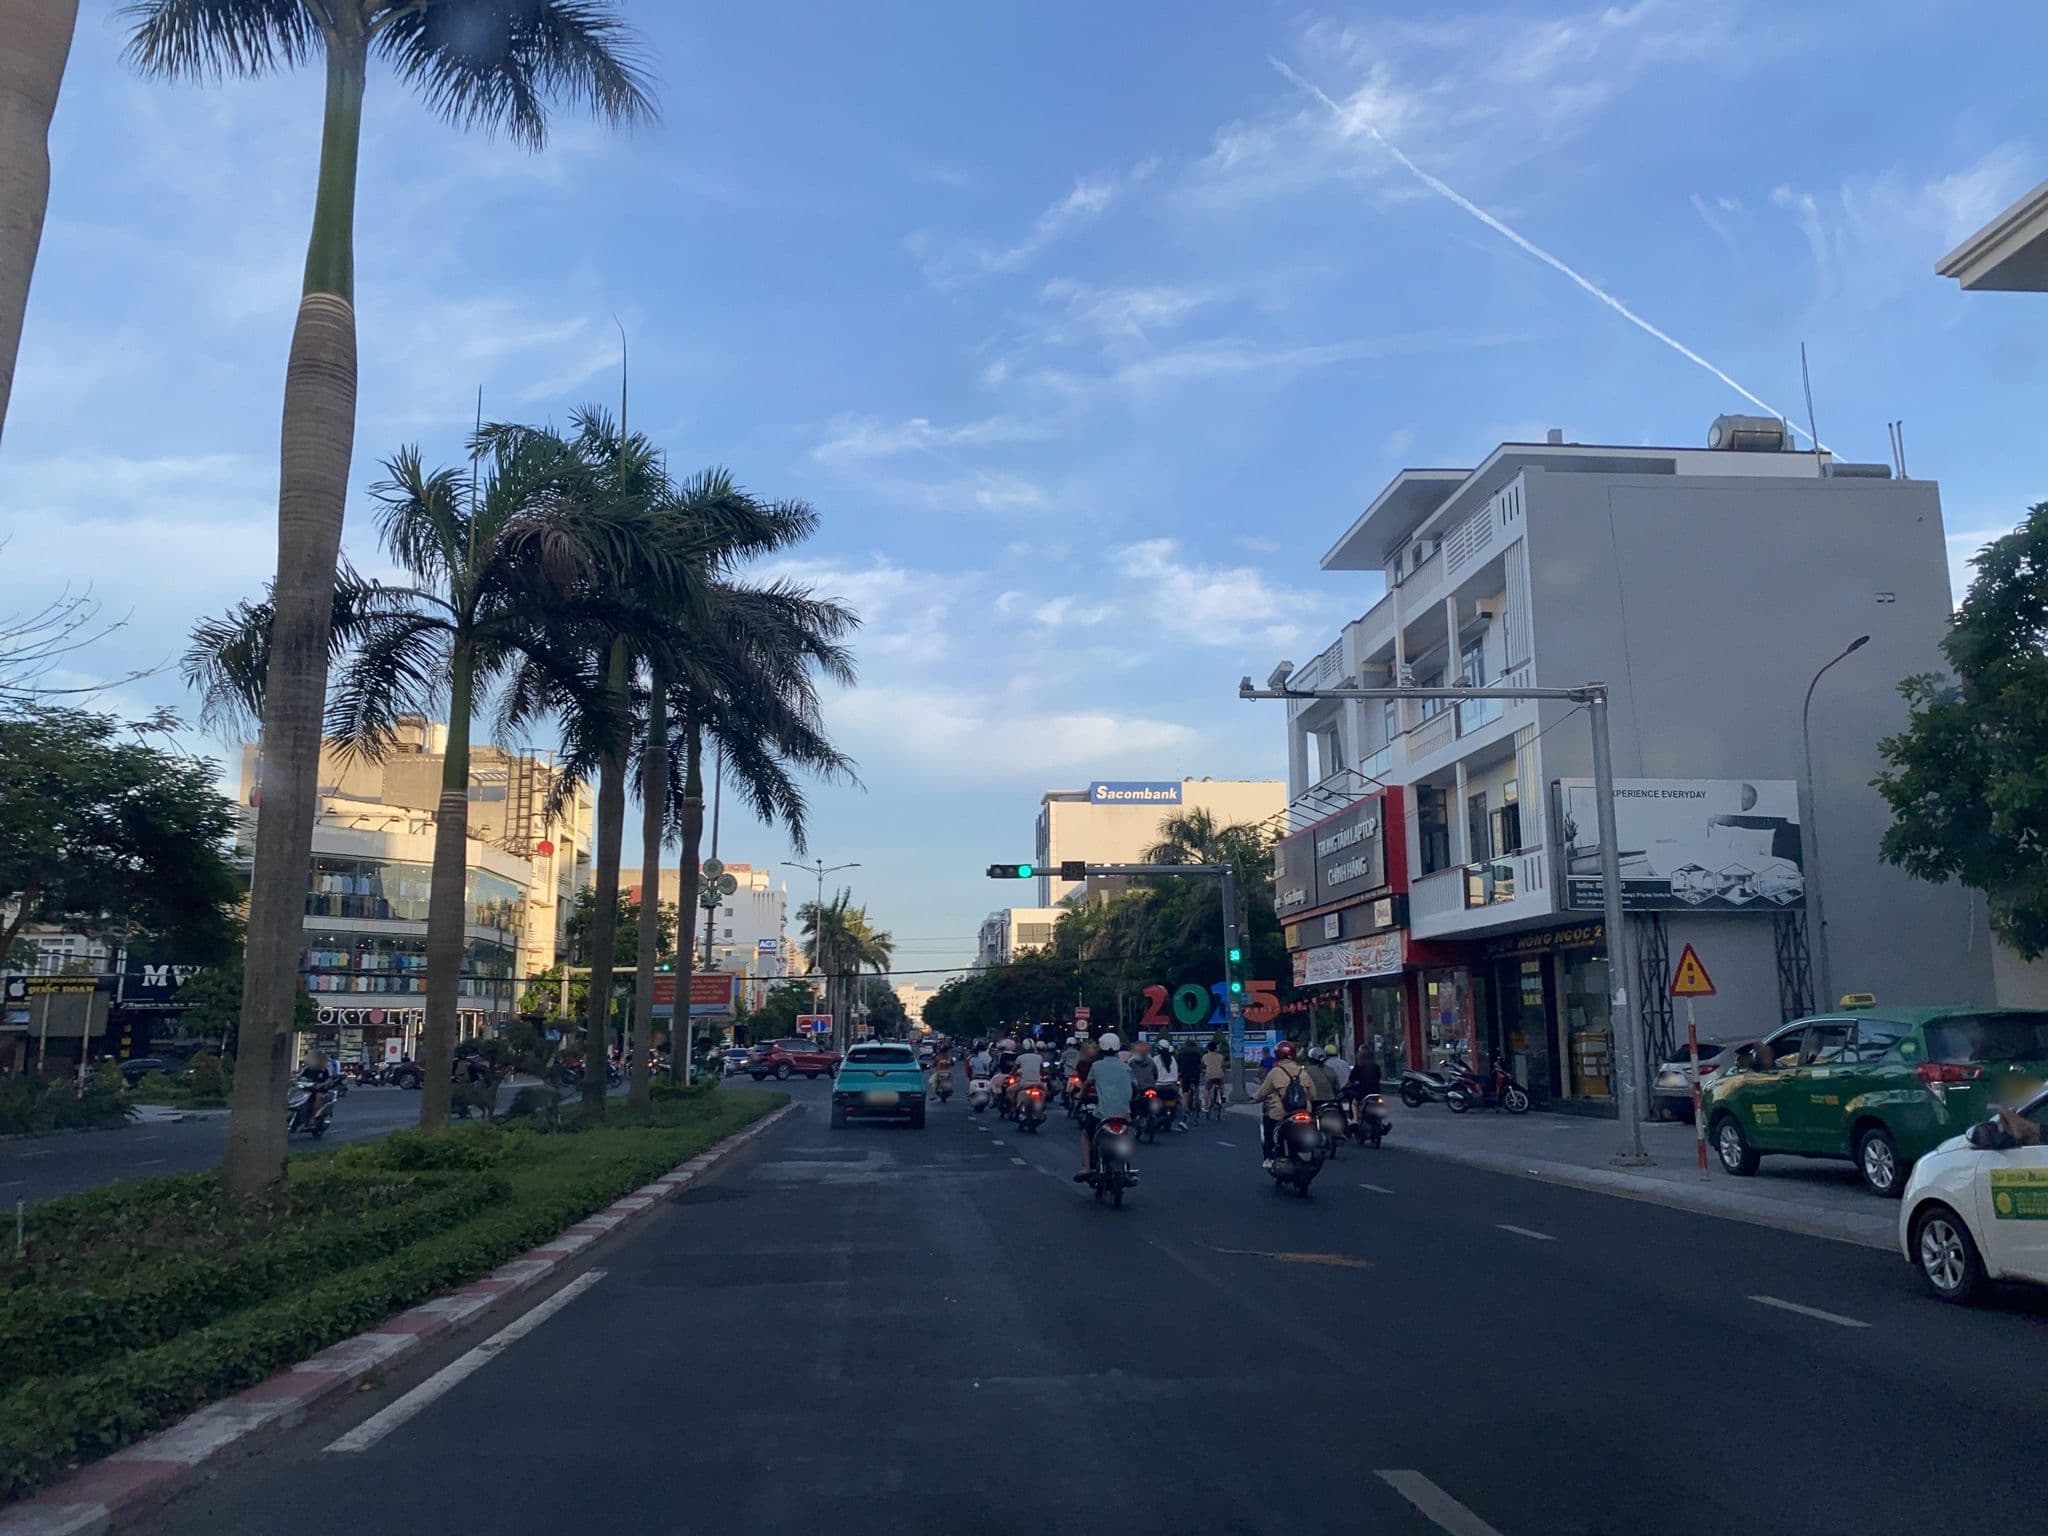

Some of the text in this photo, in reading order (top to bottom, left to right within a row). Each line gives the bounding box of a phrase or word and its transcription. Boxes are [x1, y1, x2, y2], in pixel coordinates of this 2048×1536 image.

[1096, 785, 1177, 800] Sacombank
[1612, 789, 1707, 799] XPERIENCE EVERYDAY
[1318, 817, 1377, 858] TRUNG TÂM LAPTOP
[1327, 862, 1347, 887] CHÍNH
[759, 940, 777, 948] ACB
[141, 964, 201, 987] MW
